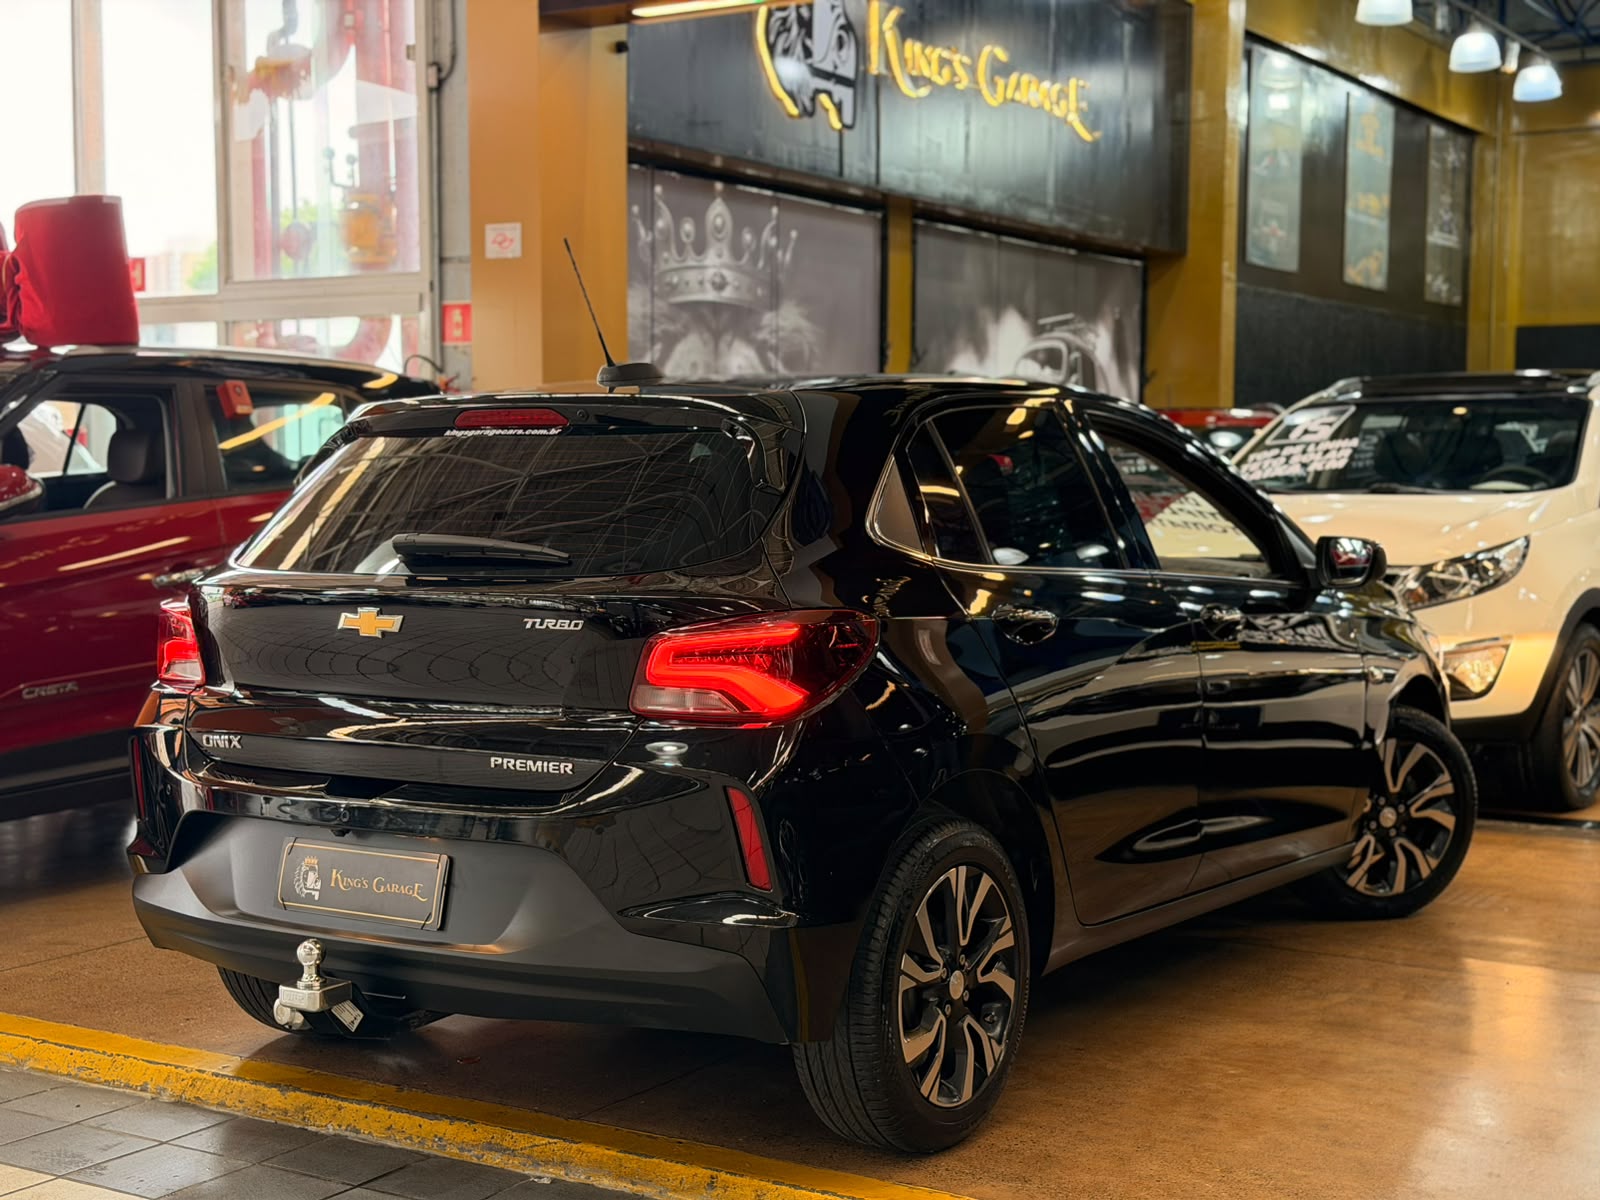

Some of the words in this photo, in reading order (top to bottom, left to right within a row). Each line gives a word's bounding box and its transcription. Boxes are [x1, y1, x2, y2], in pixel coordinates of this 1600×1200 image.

[443, 427, 562, 438] kingsgaragecars.com.br
[523, 618, 584, 631] TURBO
[202, 734, 242, 749] ONIX
[490, 756, 574, 775] PREMIER
